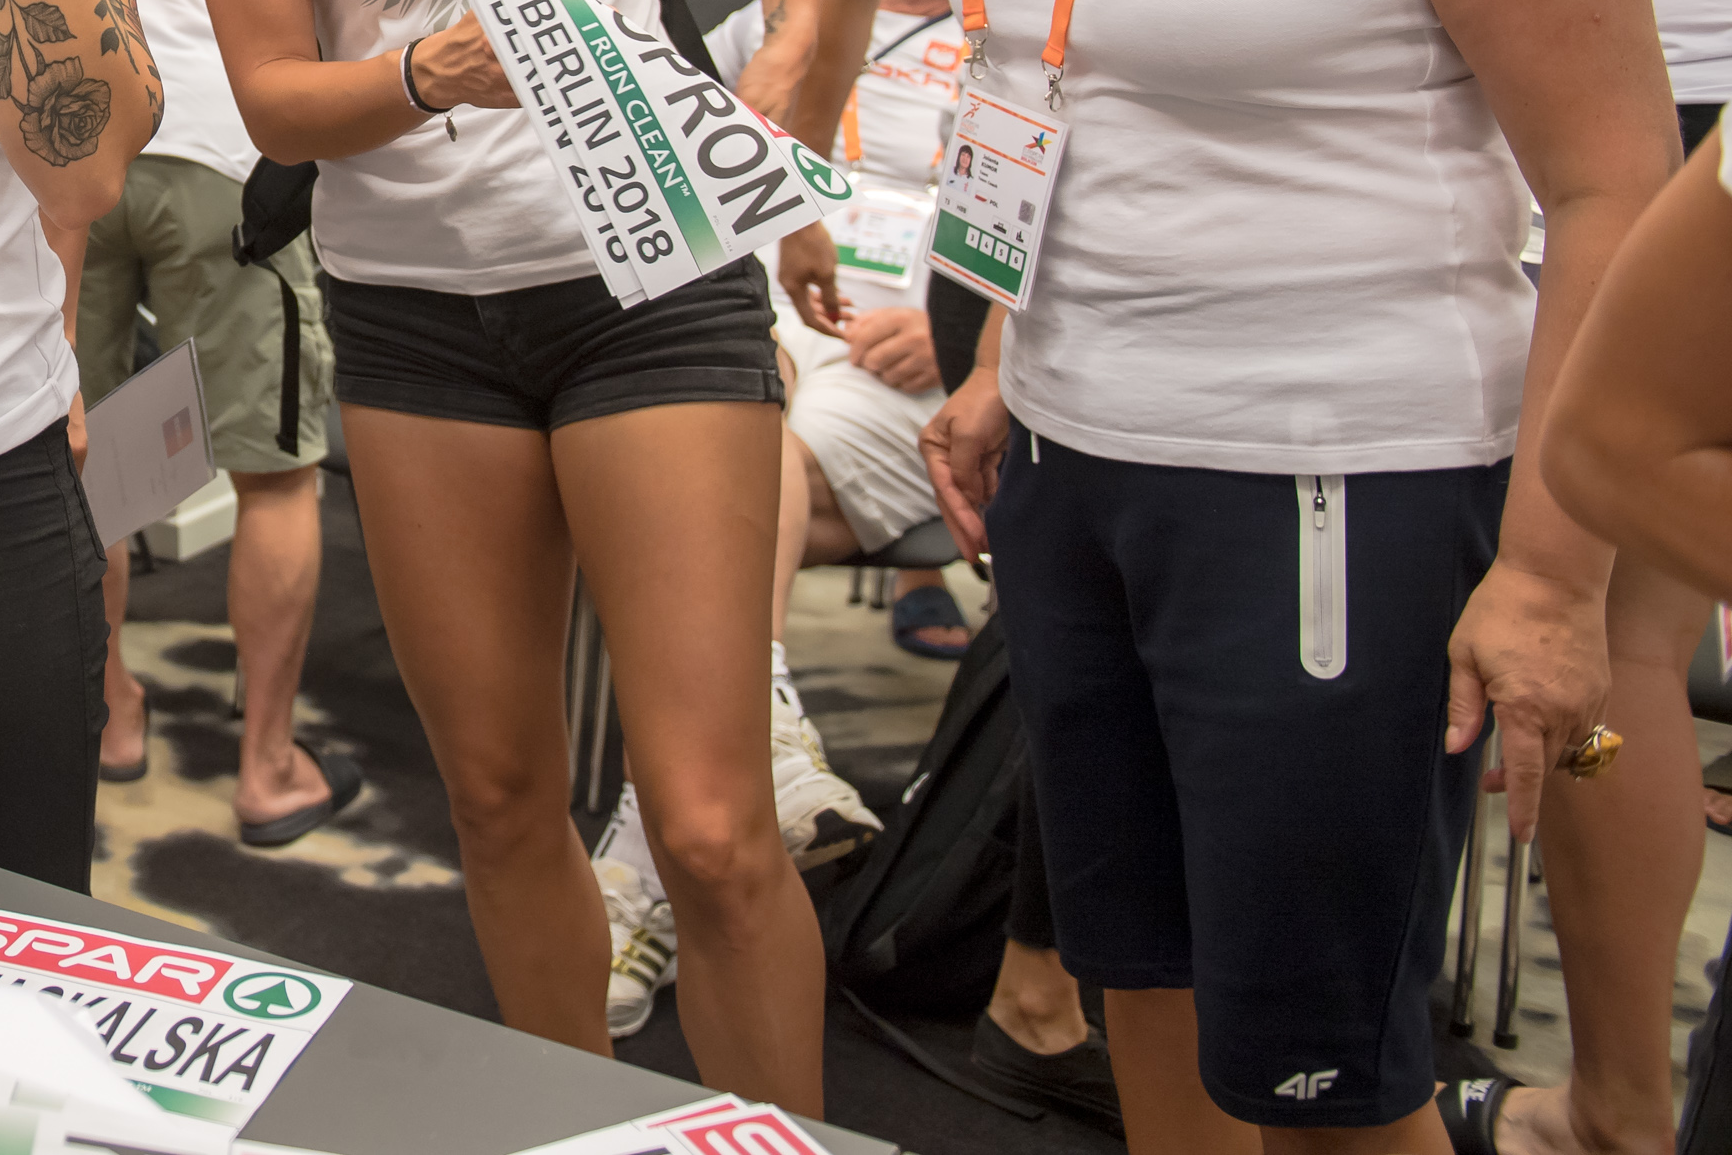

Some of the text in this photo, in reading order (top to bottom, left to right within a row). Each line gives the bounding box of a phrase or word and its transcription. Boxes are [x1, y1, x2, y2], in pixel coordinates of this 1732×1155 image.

[581, 22, 599, 32] I
[590, 36, 636, 95] RUN
[598, 155, 674, 264] 2018
[1273, 1068, 1340, 1101] 4F
